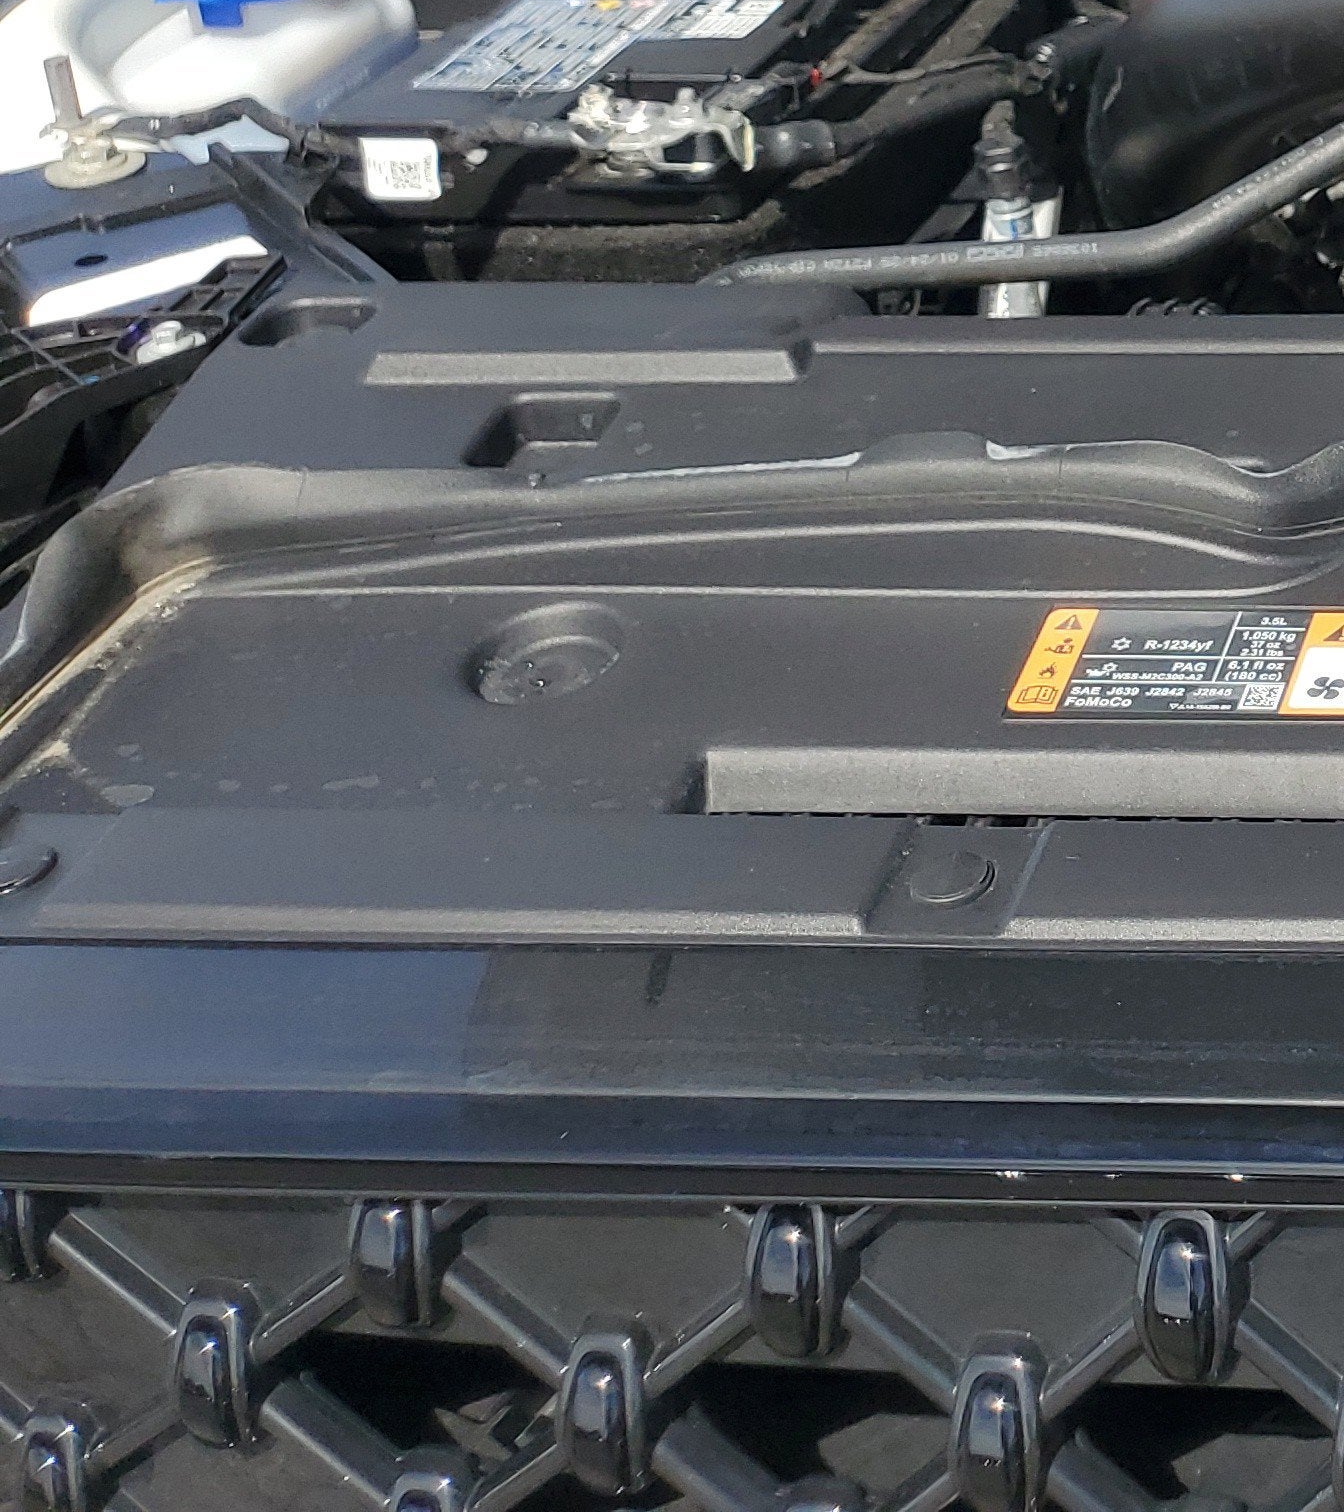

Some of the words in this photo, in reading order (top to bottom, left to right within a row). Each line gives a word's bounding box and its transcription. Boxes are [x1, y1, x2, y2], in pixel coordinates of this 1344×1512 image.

[1260, 617, 1288, 626] 3.5L
[1241, 631, 1277, 641] 1.050
[1279, 632, 1297, 643] kg
[1143, 639, 1214, 652] R-1234yf
[1250, 641, 1265, 649] 37
[1239, 649, 1263, 657] 2.31
[1265, 649, 1284, 657] lbs
[1171, 662, 1208, 672] PAG
[1227, 661, 1250, 671] 6.1
[1253, 661, 1264, 670] fl
[1259, 672, 1283, 681] cc)
[1070, 686, 1102, 695] SAE
[1106, 686, 1140, 696] J639
[1144, 687, 1186, 696] J2842
[1063, 696, 1133, 708] FoMoCo
